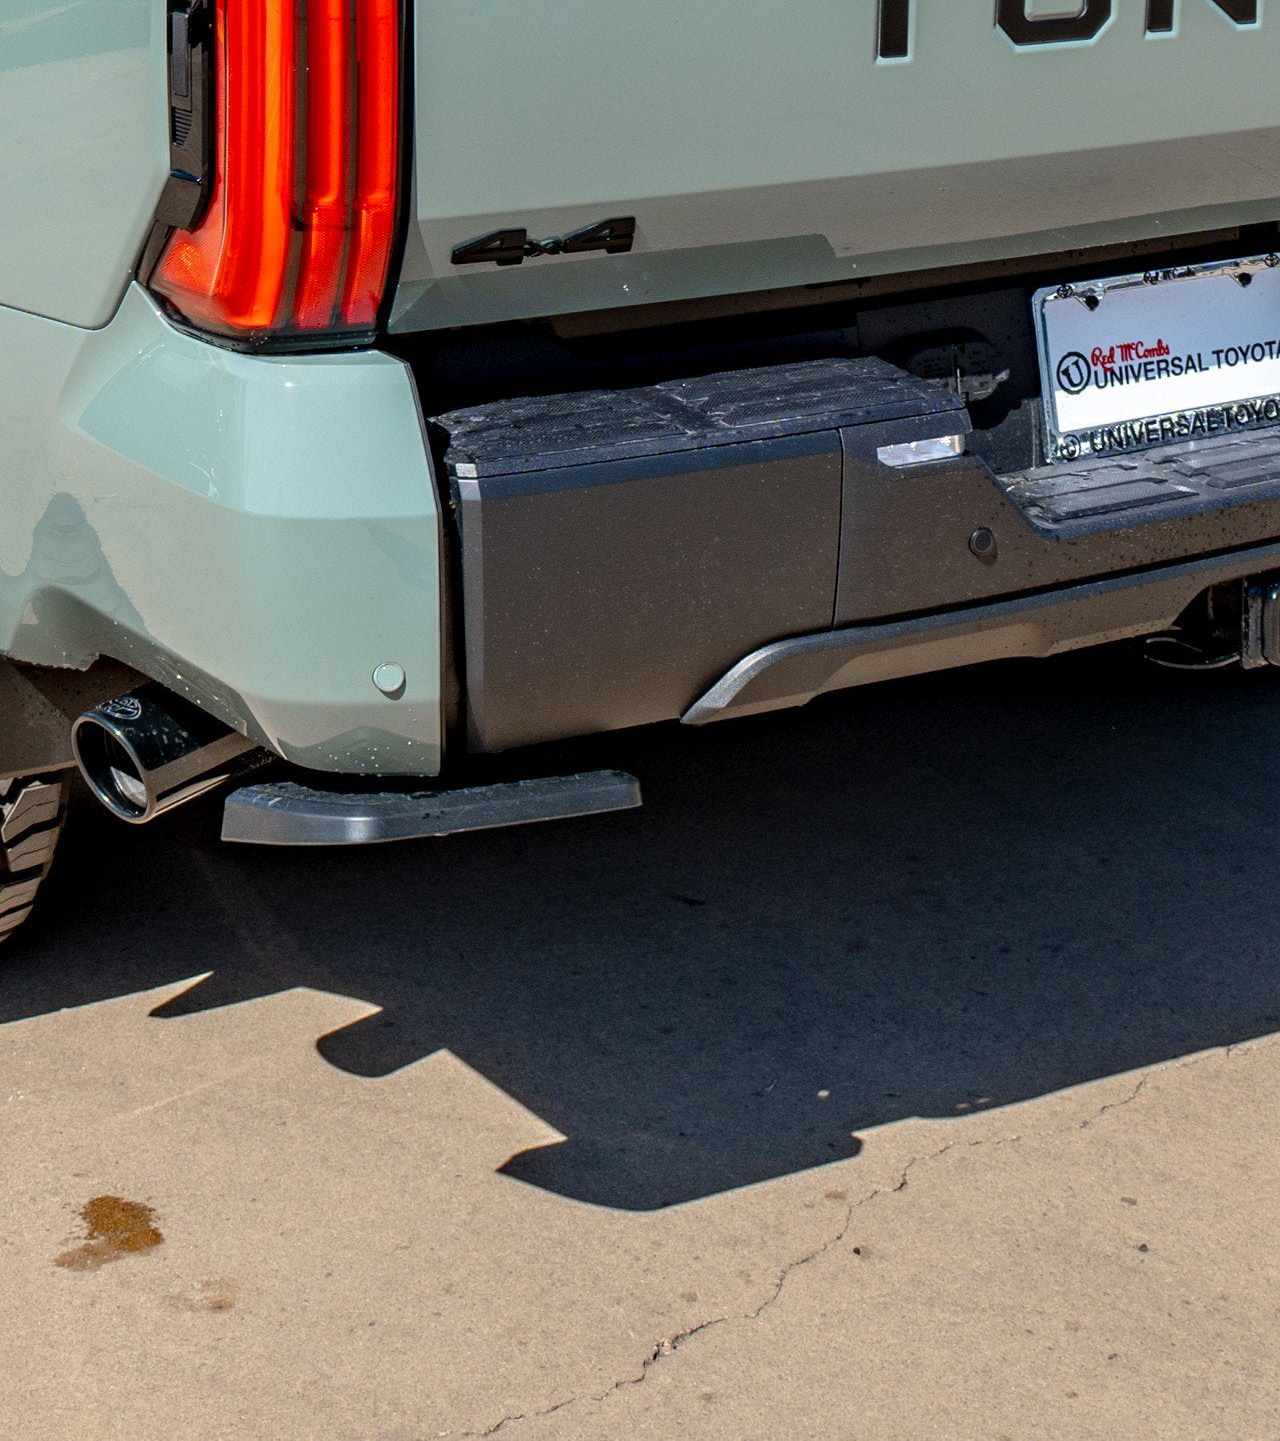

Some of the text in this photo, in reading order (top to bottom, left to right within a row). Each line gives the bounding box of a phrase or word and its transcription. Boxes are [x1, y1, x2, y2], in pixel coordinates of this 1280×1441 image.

[1091, 346, 1115, 372] Red
[1094, 352, 1209, 390] UNIVERSAL
[1089, 411, 1220, 454] UNIVERSAL
